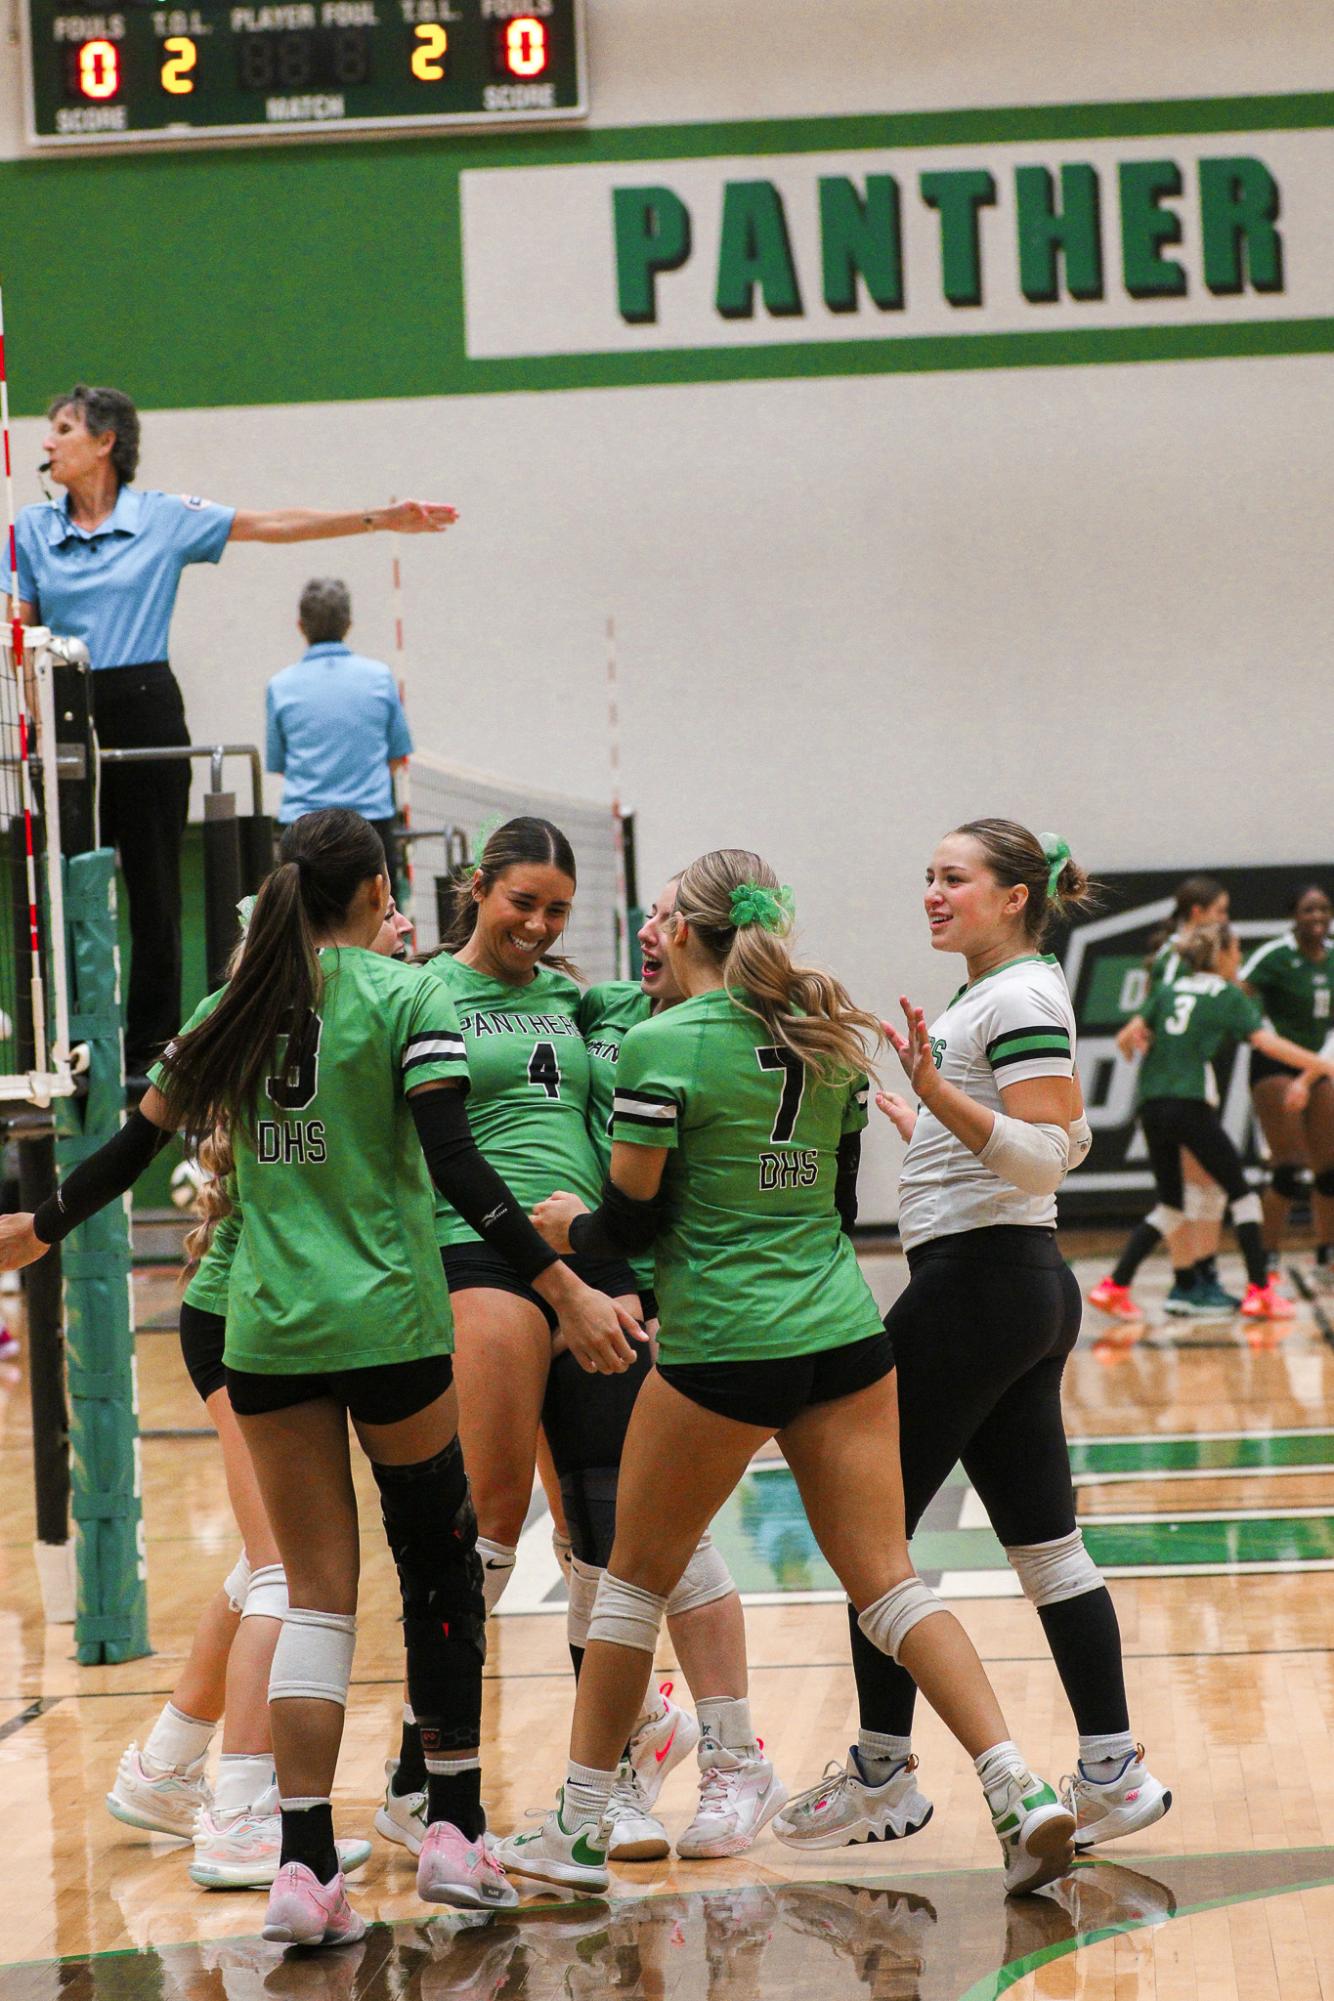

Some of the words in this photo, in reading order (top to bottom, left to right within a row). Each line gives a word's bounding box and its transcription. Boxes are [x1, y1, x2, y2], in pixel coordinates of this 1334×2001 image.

[53, 13, 126, 41] FOULS
[230, 3, 315, 32] PLAYER
[321, 1, 380, 28] FOUL
[80, 39, 118, 98] 0
[161, 36, 197, 94] 2
[411, 23, 447, 81] 2
[506, 17, 546, 76] 0
[266, 94, 345, 121] MATCH
[483, 82, 556, 111] SCORE
[56, 104, 128, 134] SCORE
[612, 156, 1285, 324] PANTHER
[1166, 995, 1197, 1035] 3
[527, 1041, 561, 1100] 4
[754, 1044, 806, 1144] 7
[257, 1120, 328, 1164] DHS
[759, 1149, 819, 1191] DHS
